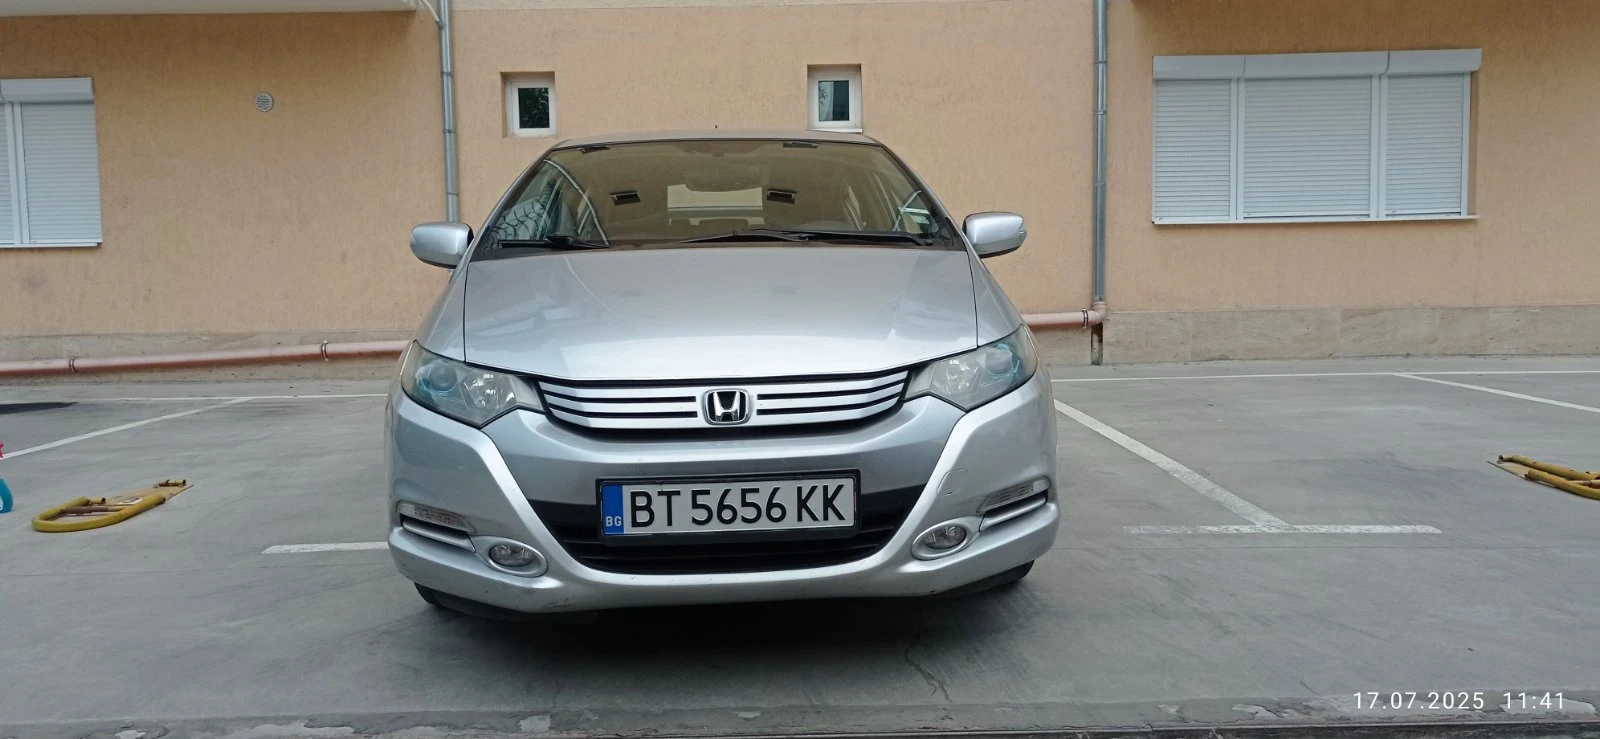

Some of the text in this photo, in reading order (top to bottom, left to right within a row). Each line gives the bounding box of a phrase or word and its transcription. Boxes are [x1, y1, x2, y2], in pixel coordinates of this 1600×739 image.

[630, 484, 846, 528] BT 5656 KK
[605, 516, 622, 527] BG
